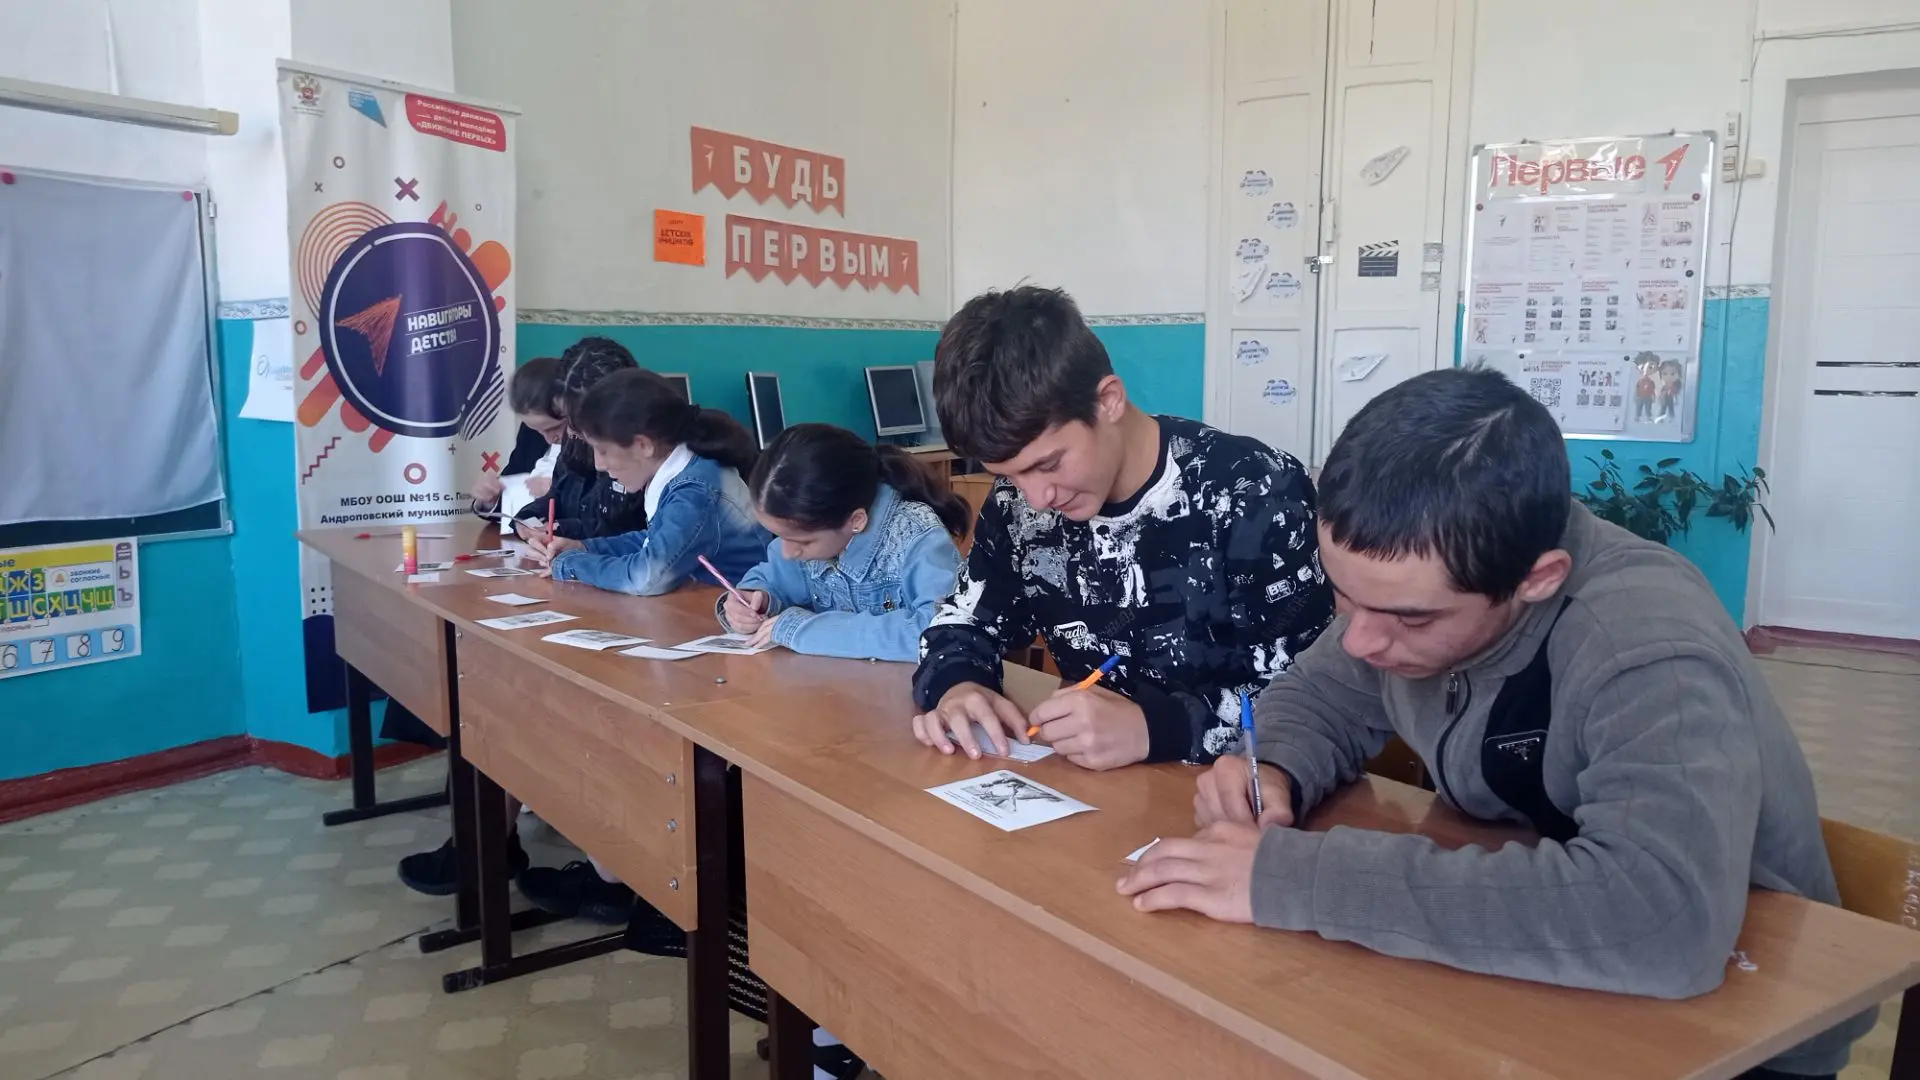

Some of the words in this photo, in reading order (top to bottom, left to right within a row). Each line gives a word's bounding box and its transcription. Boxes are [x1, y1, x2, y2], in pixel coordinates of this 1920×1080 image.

[733, 145, 839, 202] БУДЬ
[731, 224, 890, 278] ПЕРВЫМ
[320, 509, 404, 524] Андроповский
[340, 496, 372, 507] МБОУ
[375, 494, 406, 504] ООШ
[409, 492, 440, 503] №15
